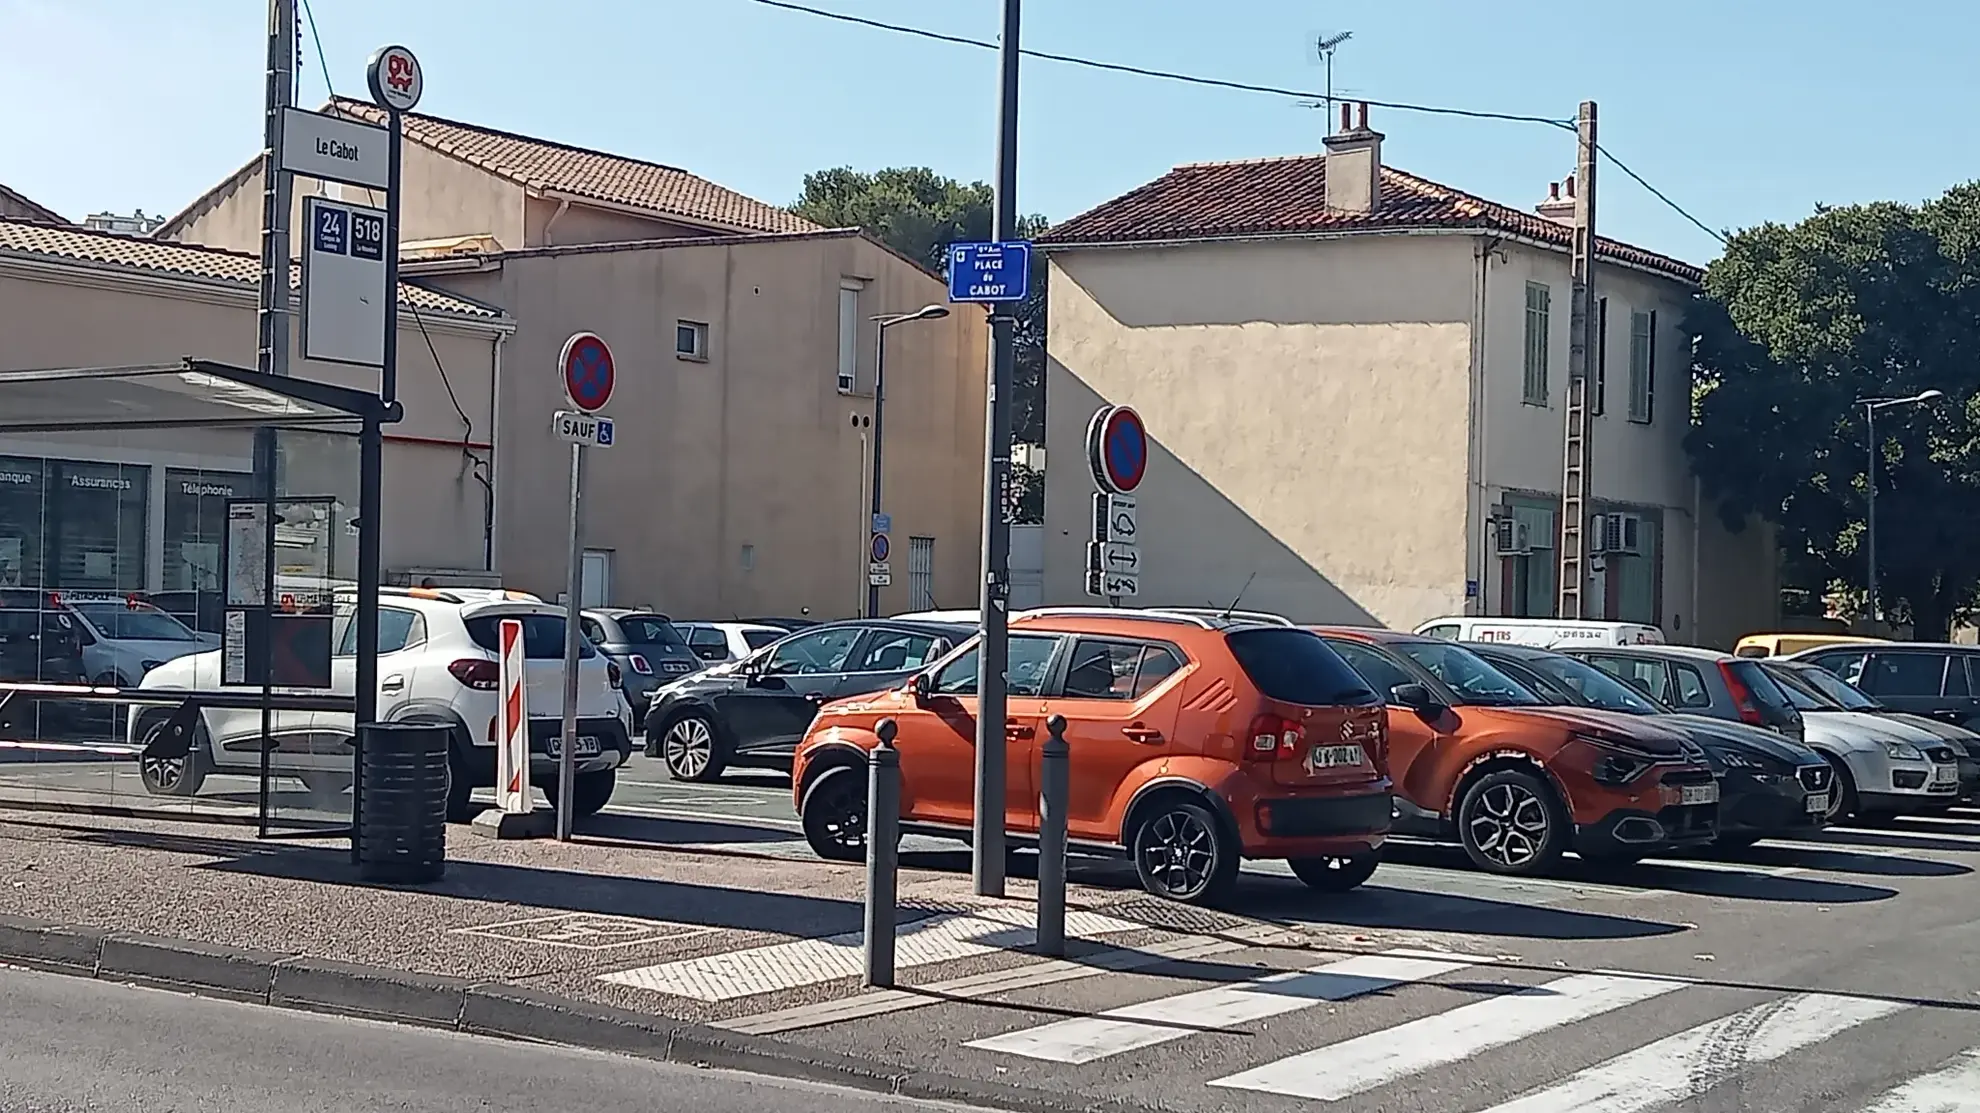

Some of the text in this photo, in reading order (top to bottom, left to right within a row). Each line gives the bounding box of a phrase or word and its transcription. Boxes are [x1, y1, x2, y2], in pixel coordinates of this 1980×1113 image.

[316, 137, 359, 161] Le Cabot
[322, 211, 340, 235] 24
[355, 217, 380, 241] 518
[974, 259, 1003, 270] PLACE
[983, 272, 993, 282] du
[969, 284, 1006, 295] CABOT
[563, 420, 595, 439] SAUF
[71, 474, 131, 489] Assurances
